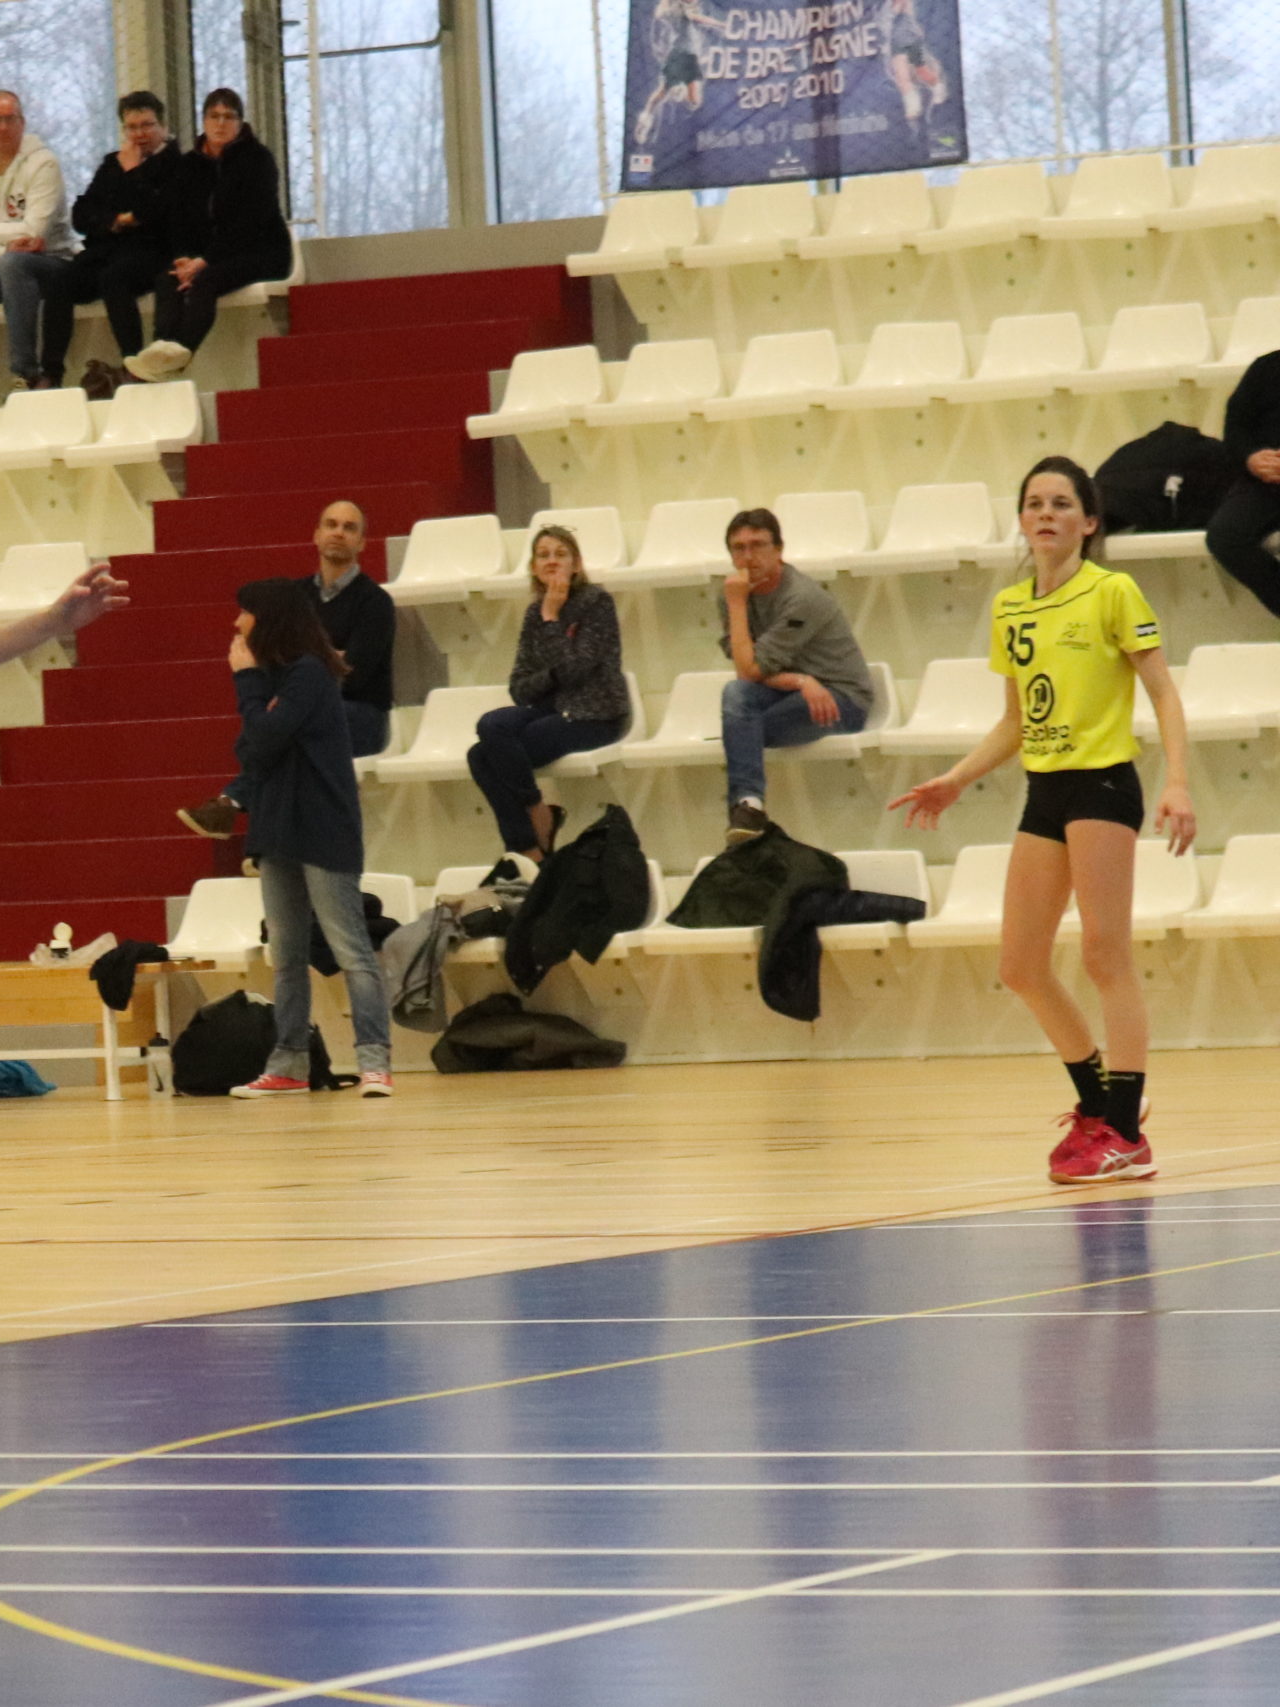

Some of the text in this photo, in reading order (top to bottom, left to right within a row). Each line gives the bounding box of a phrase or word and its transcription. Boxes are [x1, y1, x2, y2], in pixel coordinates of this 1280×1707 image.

[705, 22, 878, 79] DE BRETAGNE
[792, 70, 844, 99] 2010
